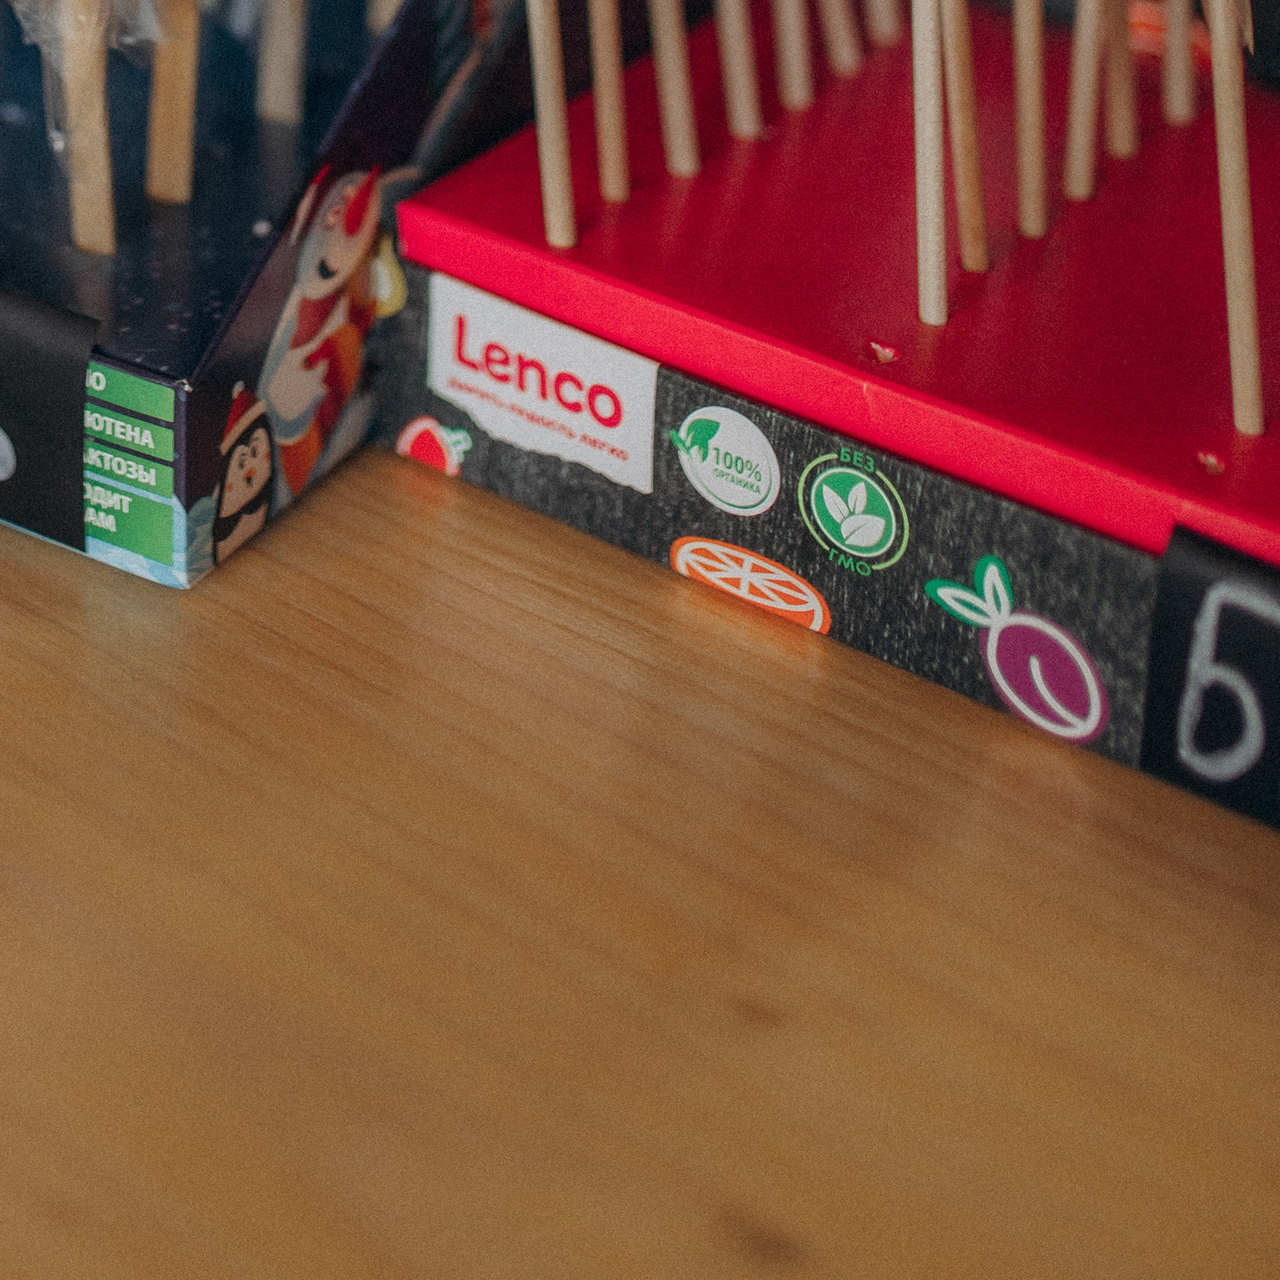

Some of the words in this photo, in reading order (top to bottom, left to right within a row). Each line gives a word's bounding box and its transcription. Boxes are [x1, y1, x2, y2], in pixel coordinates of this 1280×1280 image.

[453, 313, 623, 428] Lenco
[713, 447, 762, 482] 100%
[840, 447, 875, 474] БЕЗ
[828, 548, 872, 577] ГМО
